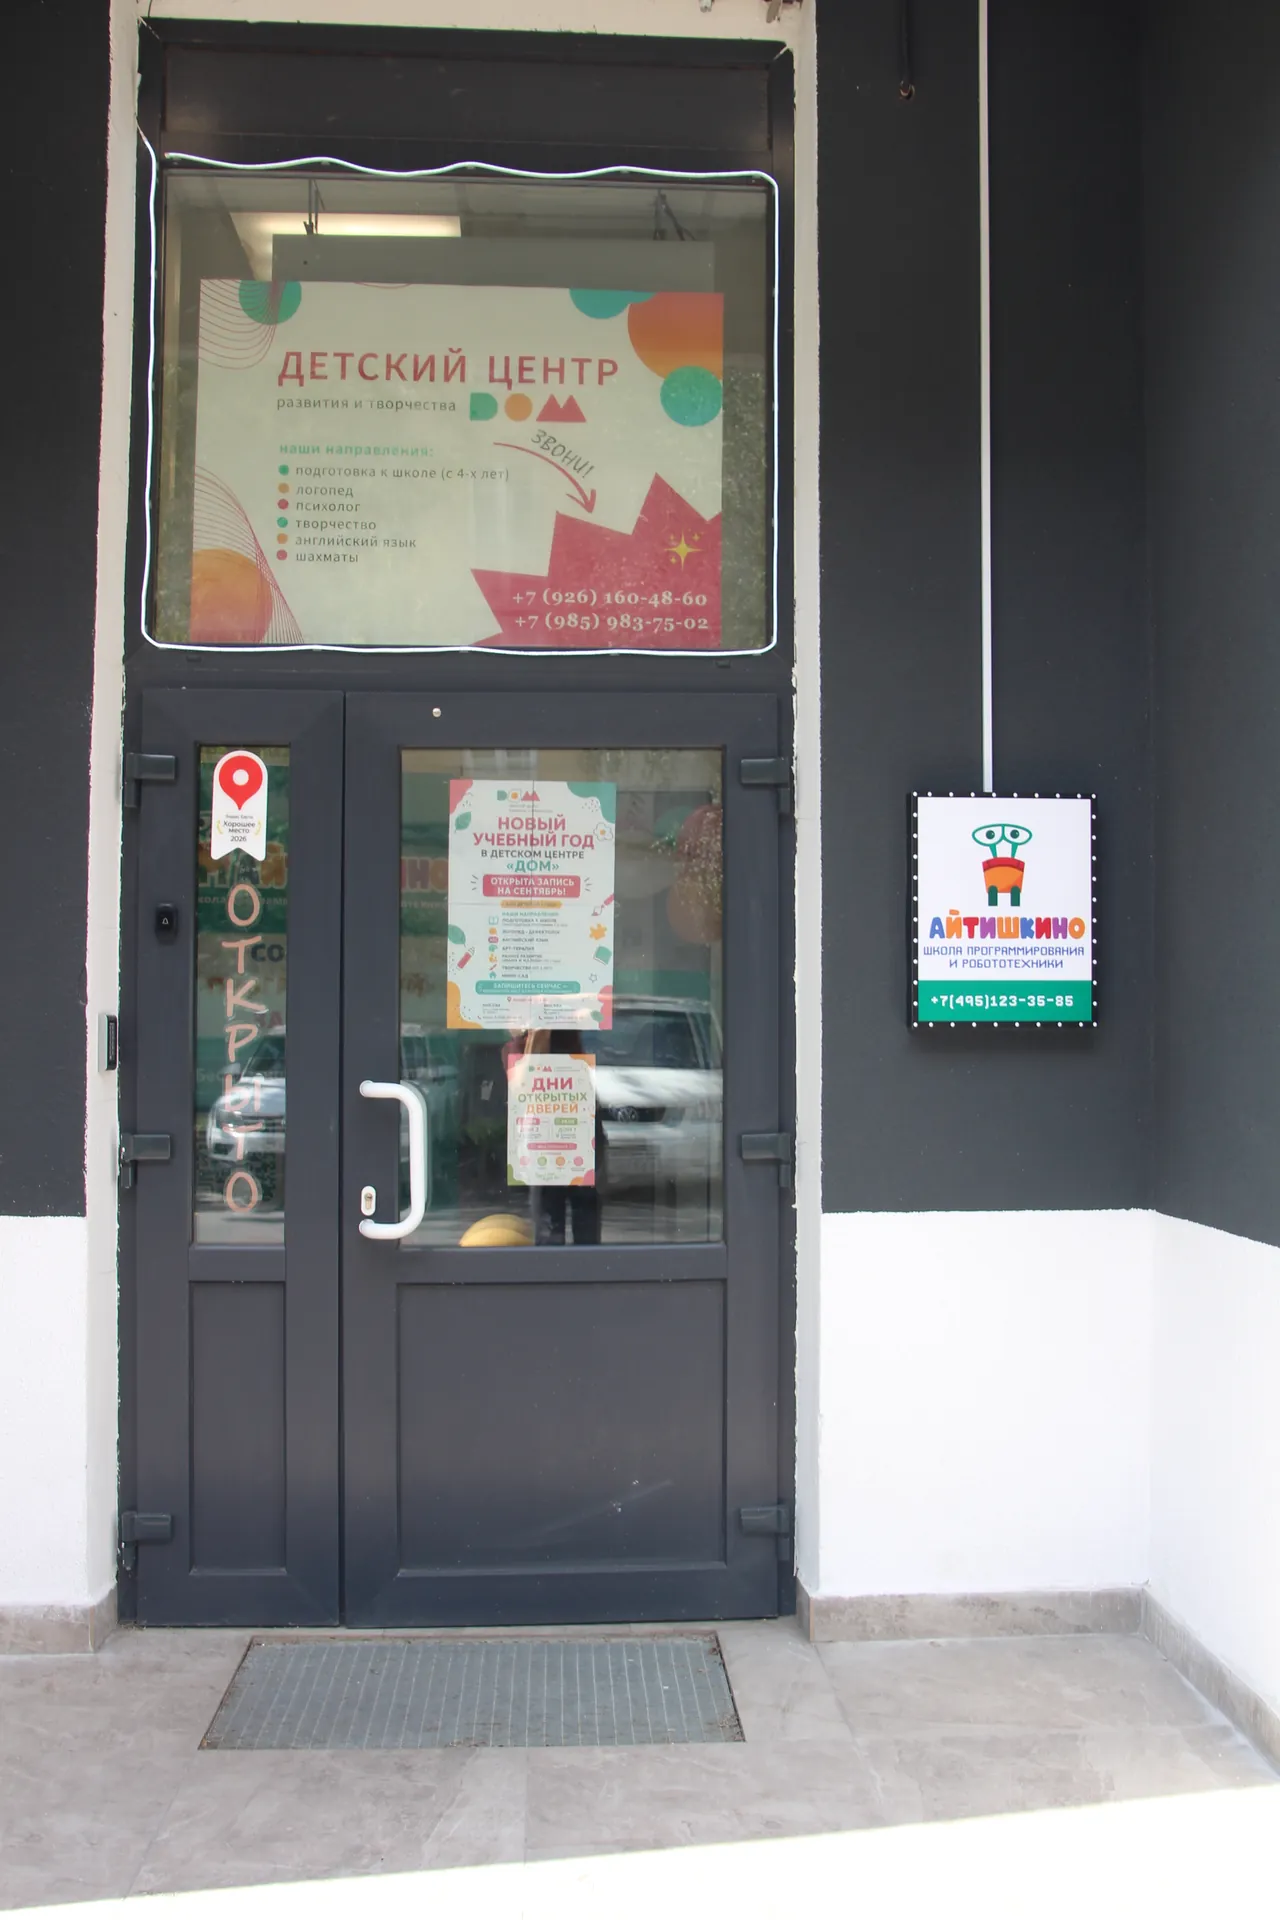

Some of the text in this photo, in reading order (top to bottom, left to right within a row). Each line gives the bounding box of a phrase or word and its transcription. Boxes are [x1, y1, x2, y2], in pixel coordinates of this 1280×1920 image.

[277, 347, 618, 390] ДЕТСКИЙ ЦЕНТР
[276, 396, 349, 411] развития
[353, 400, 363, 409] и
[369, 399, 456, 412] творчества
[279, 444, 434, 457] наши направления:
[531, 429, 595, 478] ЗВОНИ!
[295, 466, 510, 481] подготовка к школе (с 4-х лет)
[295, 485, 354, 498] логопед
[295, 501, 361, 512] психолог
[295, 519, 377, 531] творчество
[295, 535, 417, 549] английский язык
[295, 552, 359, 564] шахматы
[512, 588, 708, 607] +7 (926) 160-48-60
[515, 612, 709, 632] +7 (985) 983-75-02
[223, 820, 256, 828] Хорошее
[497, 814, 566, 831] НОВЫЙ
[473, 831, 594, 849] УЧЕБНЫЙ ГОД
[481, 849, 584, 859] В ДЕТСКОМ ЦЕНТРЕ
[506, 860, 560, 873] «ДОМ»
[490, 877, 575, 887] ОТКРЫТА ЗАПИСЬ
[497, 887, 567, 896] НА СЕНТЯБРЬ!
[929, 909, 1086, 940] АЙТИШКИНО
[923, 946, 1085, 956] ШКОЛА ПРОГРАММИРОВАНИЯ
[949, 959, 1064, 969] И РОБОТОТЕХНИКИ
[931, 994, 1074, 1010] +7(495)123-35-85
[222, 883, 268, 1212] ОТКРЫТО
[531, 1077, 573, 1092] ДНИ
[518, 1092, 588, 1103] ОТКРЫТЫХ
[526, 1101, 579, 1114] ДВЕРЕЙ
